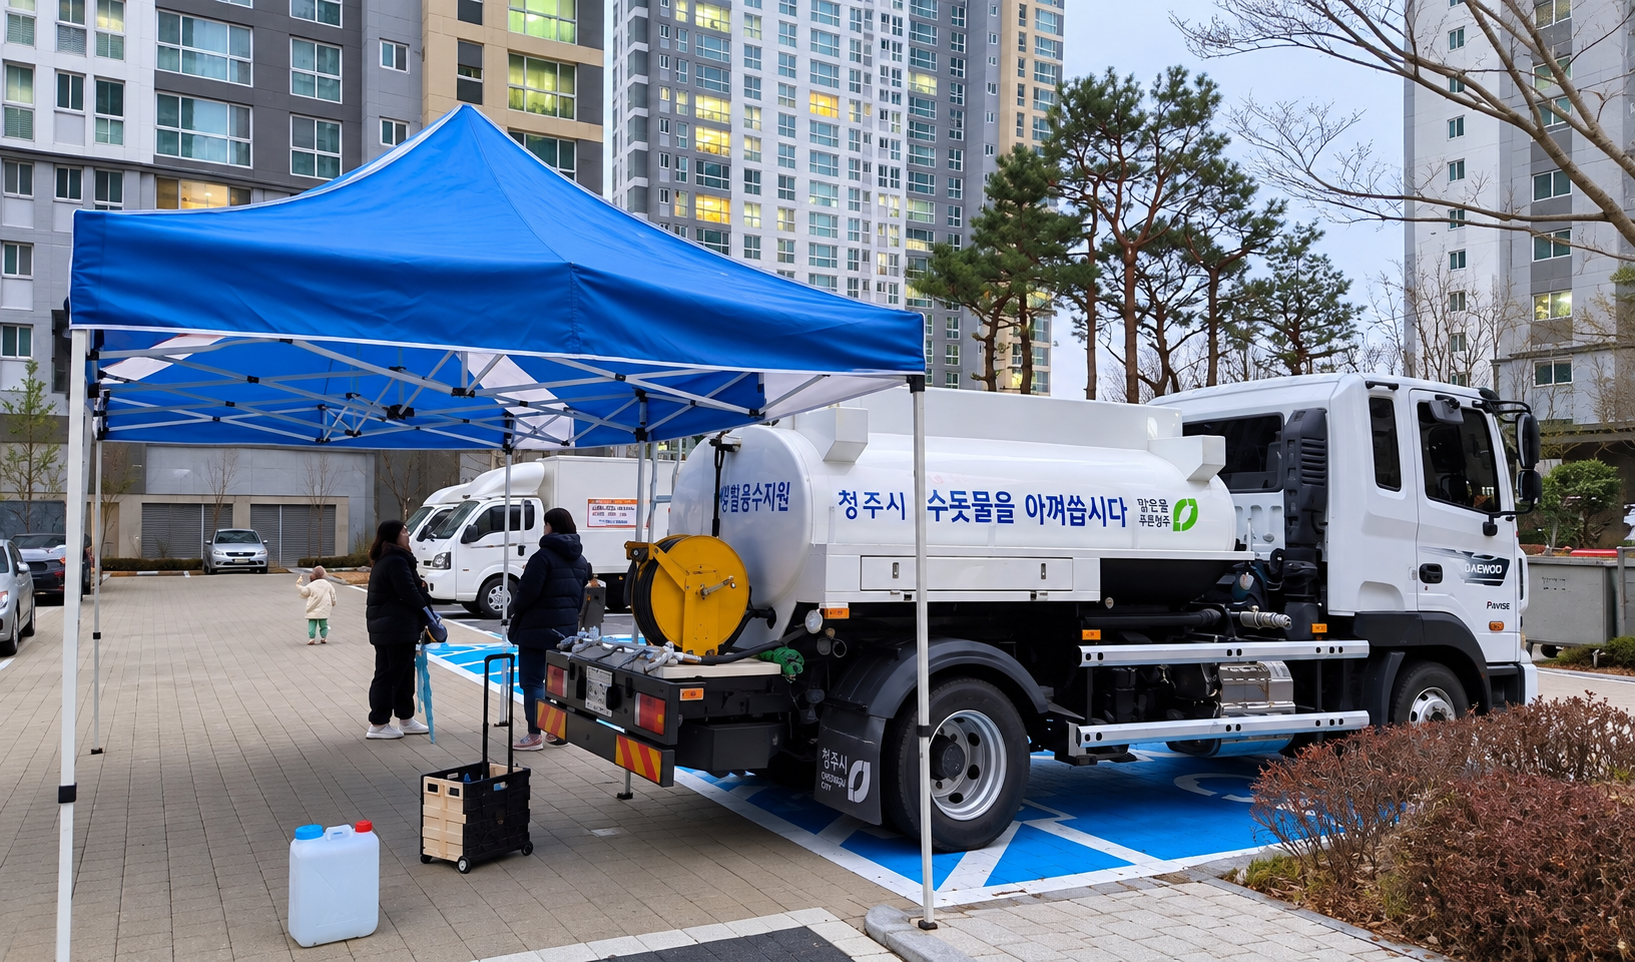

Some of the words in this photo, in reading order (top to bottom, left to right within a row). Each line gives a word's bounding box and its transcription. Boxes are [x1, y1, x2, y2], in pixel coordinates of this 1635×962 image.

[838, 489, 906, 520] 청주시
[927, 489, 1016, 524] 수돗물을
[1025, 493, 1128, 528] 아껴씁시다
[1464, 563, 1503, 574] DAEWOO
[822, 748, 848, 775] 청주시
